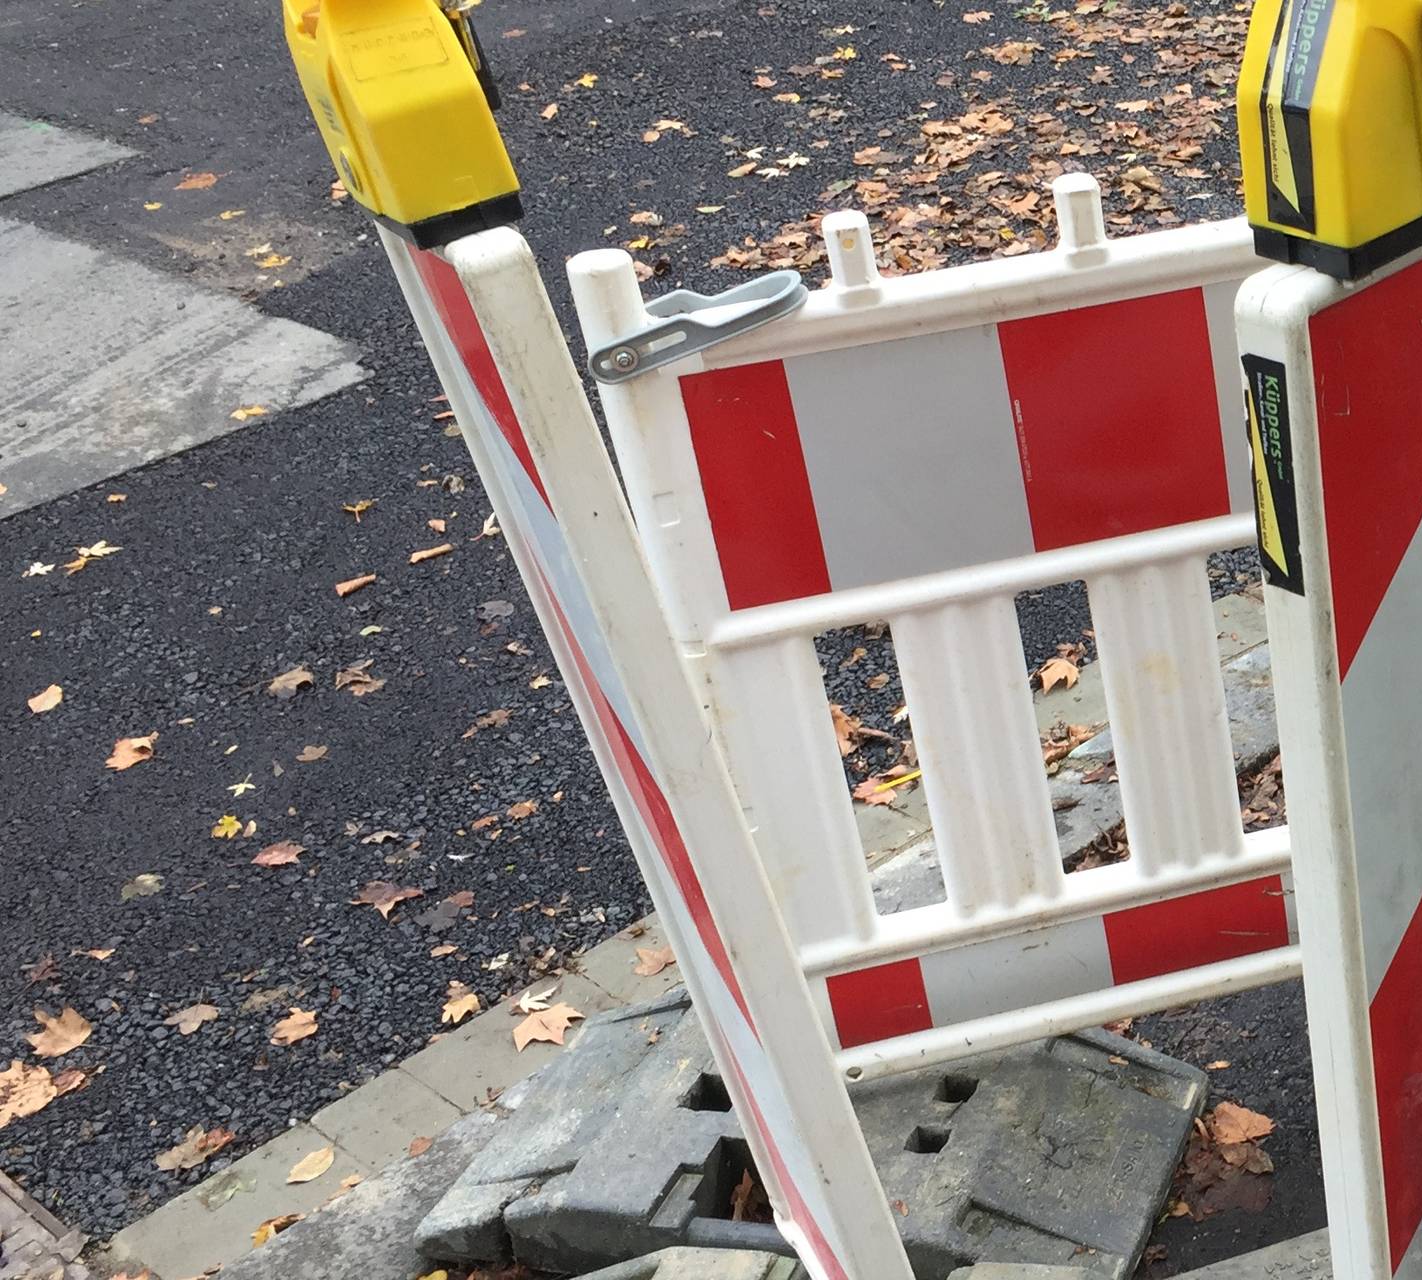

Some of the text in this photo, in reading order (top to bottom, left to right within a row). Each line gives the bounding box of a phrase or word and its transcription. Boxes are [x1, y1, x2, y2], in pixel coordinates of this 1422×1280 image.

[1295, 0, 1327, 75] üppers
[1267, 103, 1276, 136] Qualität
[1264, 375, 1281, 458] Küppers
[1256, 479, 1264, 511] Qualität
